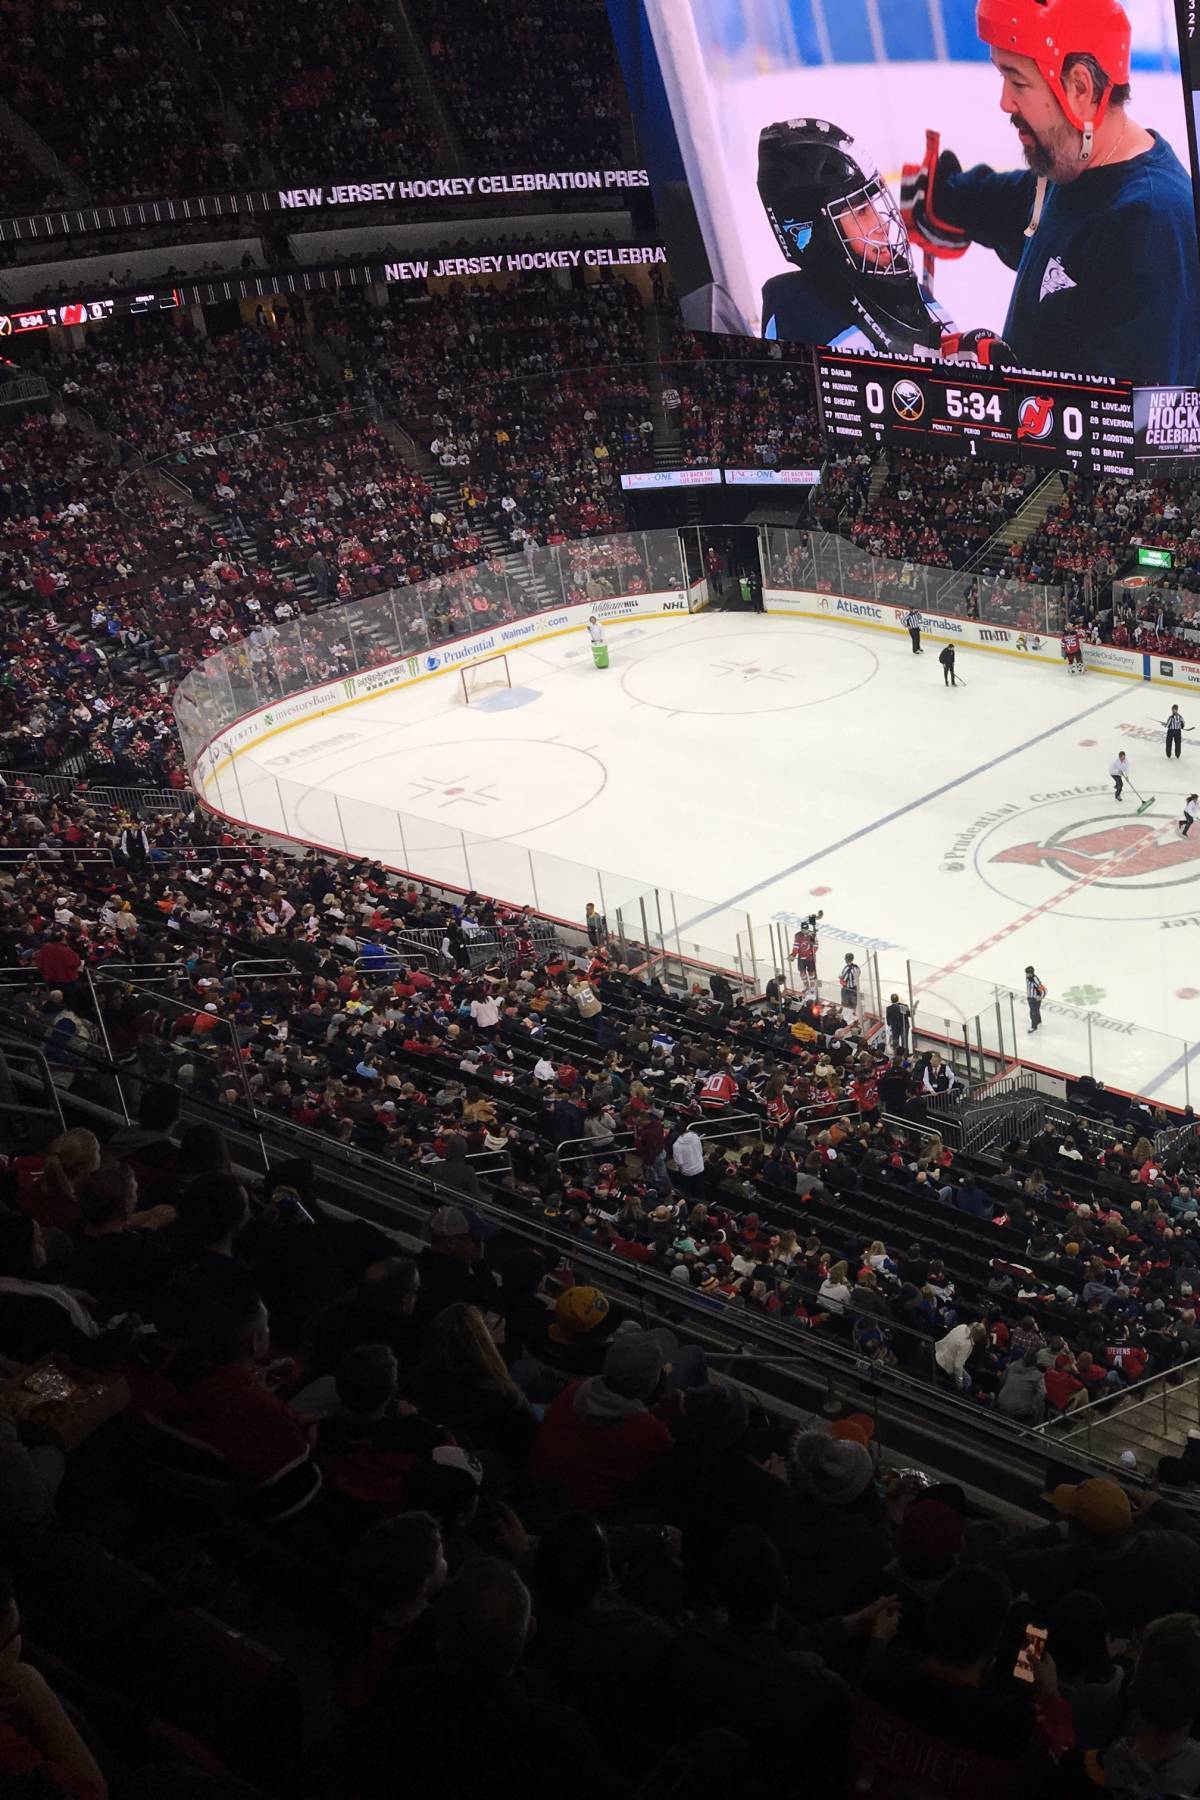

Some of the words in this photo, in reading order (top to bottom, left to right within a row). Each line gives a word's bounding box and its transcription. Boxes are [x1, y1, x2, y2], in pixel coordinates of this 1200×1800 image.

[1188, 13, 1196, 24] 2
[1188, 27, 1195, 38] 7
[278, 187, 322, 210] NEW
[326, 181, 395, 206] JERSEY
[399, 176, 475, 199] HOCKEY
[478, 170, 601, 194] CELEBRATION
[603, 169, 650, 188] PRES
[384, 261, 428, 281] NEW
[433, 255, 503, 277] JERSEY
[507, 249, 582, 272] HOCKEY
[584, 245, 666, 266] CELEBRA
[20, 314, 44, 328] 5:34
[93, 304, 102, 318] 0
[831, 367, 852, 378] DAHLIN
[866, 382, 885, 414] 0
[946, 389, 1002, 423] 5:34
[1090, 400, 1098, 408] 12
[1101, 402, 1132, 412] LOVEJOY
[1150, 393, 1177, 408] NEW
[1063, 406, 1083, 441] 0
[1102, 418, 1134, 428] SEVERSON
[932, 424, 953, 432] PENALTY
[991, 431, 1012, 440] PENALTY
[1092, 432, 1100, 440] 17
[1102, 434, 1134, 445] AGOSTINO
[970, 440, 977, 456] 1
[1103, 449, 1124, 458] BRATT
[1072, 460, 1078, 469] 7
[1103, 465, 1135, 476] HISCHIER
[662, 601, 688, 610] NHL
[836, 599, 882, 619] Atlantic
[500, 623, 536, 642] Walmart
[444, 636, 495, 664] Prudential
[274, 691, 337, 721] investorsBank
[944, 803, 1021, 860] Prudential
[1029, 784, 1110, 803] Center
[574, 988, 594, 1007] 75
[1104, 1347, 1131, 1356] STEVENS
